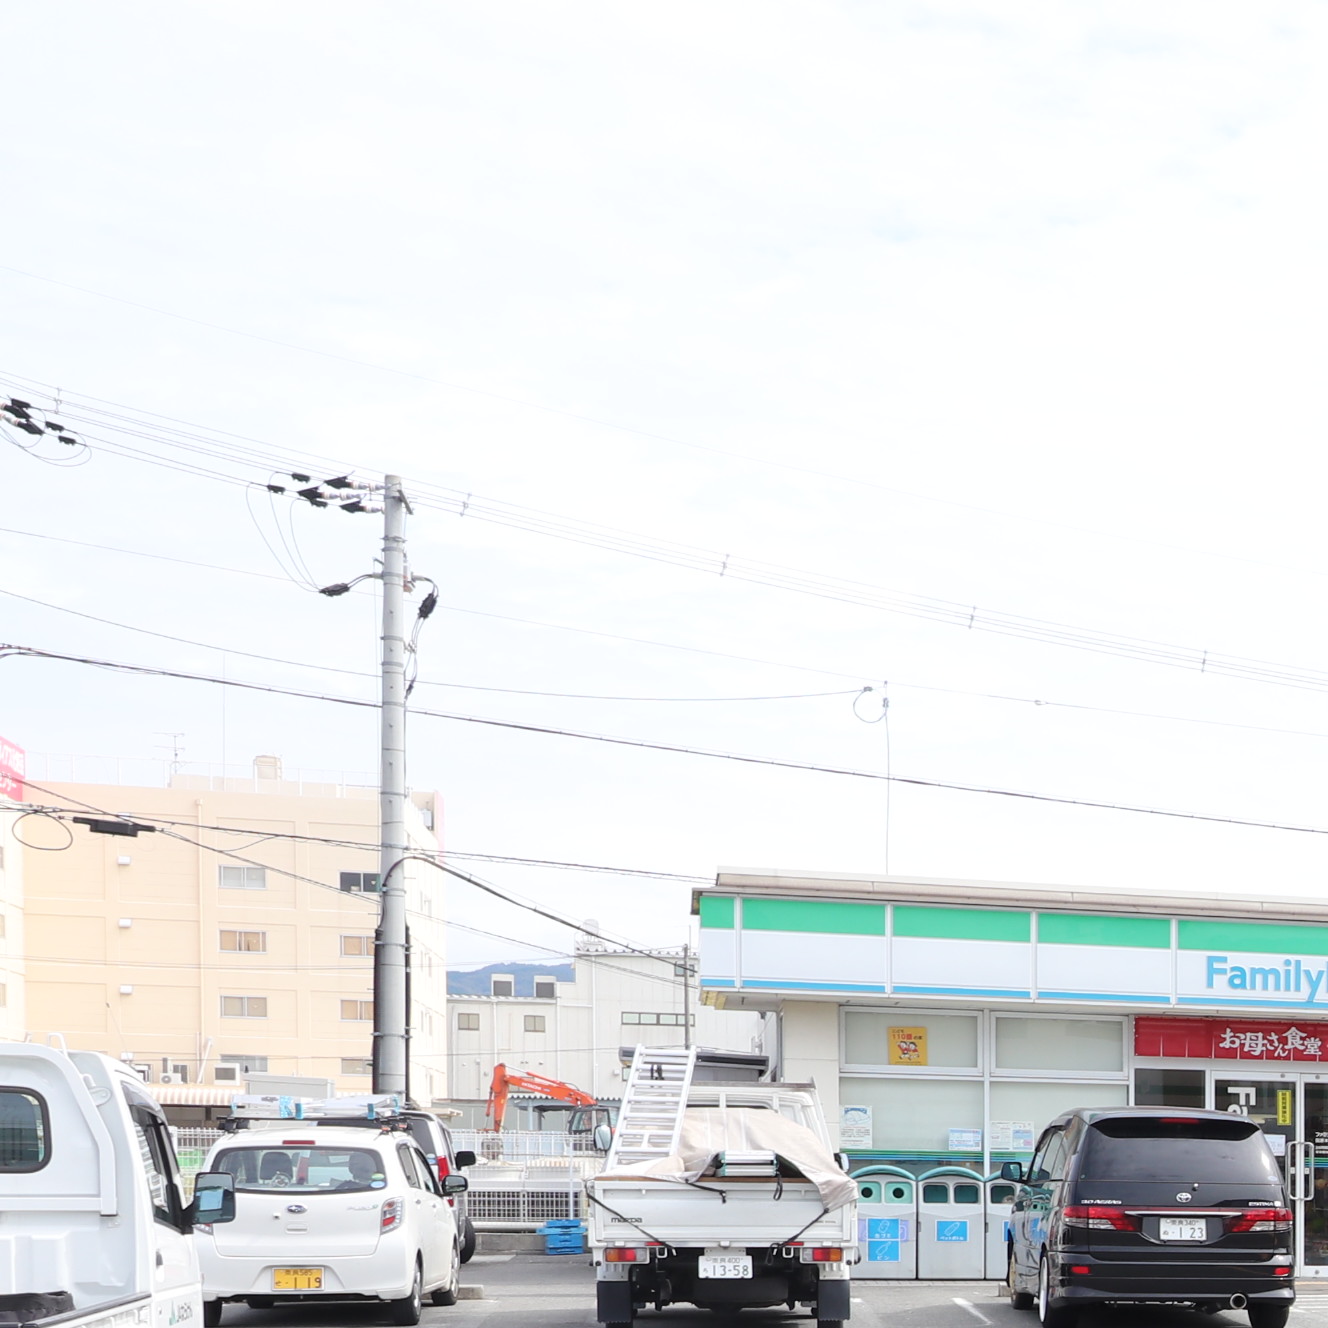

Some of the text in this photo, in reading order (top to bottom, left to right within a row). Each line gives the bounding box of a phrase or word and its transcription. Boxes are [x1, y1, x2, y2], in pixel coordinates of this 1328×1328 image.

[1219, 1026, 1322, 1058] お母さん食堂
[712, 1264, 750, 1277] 13-58
